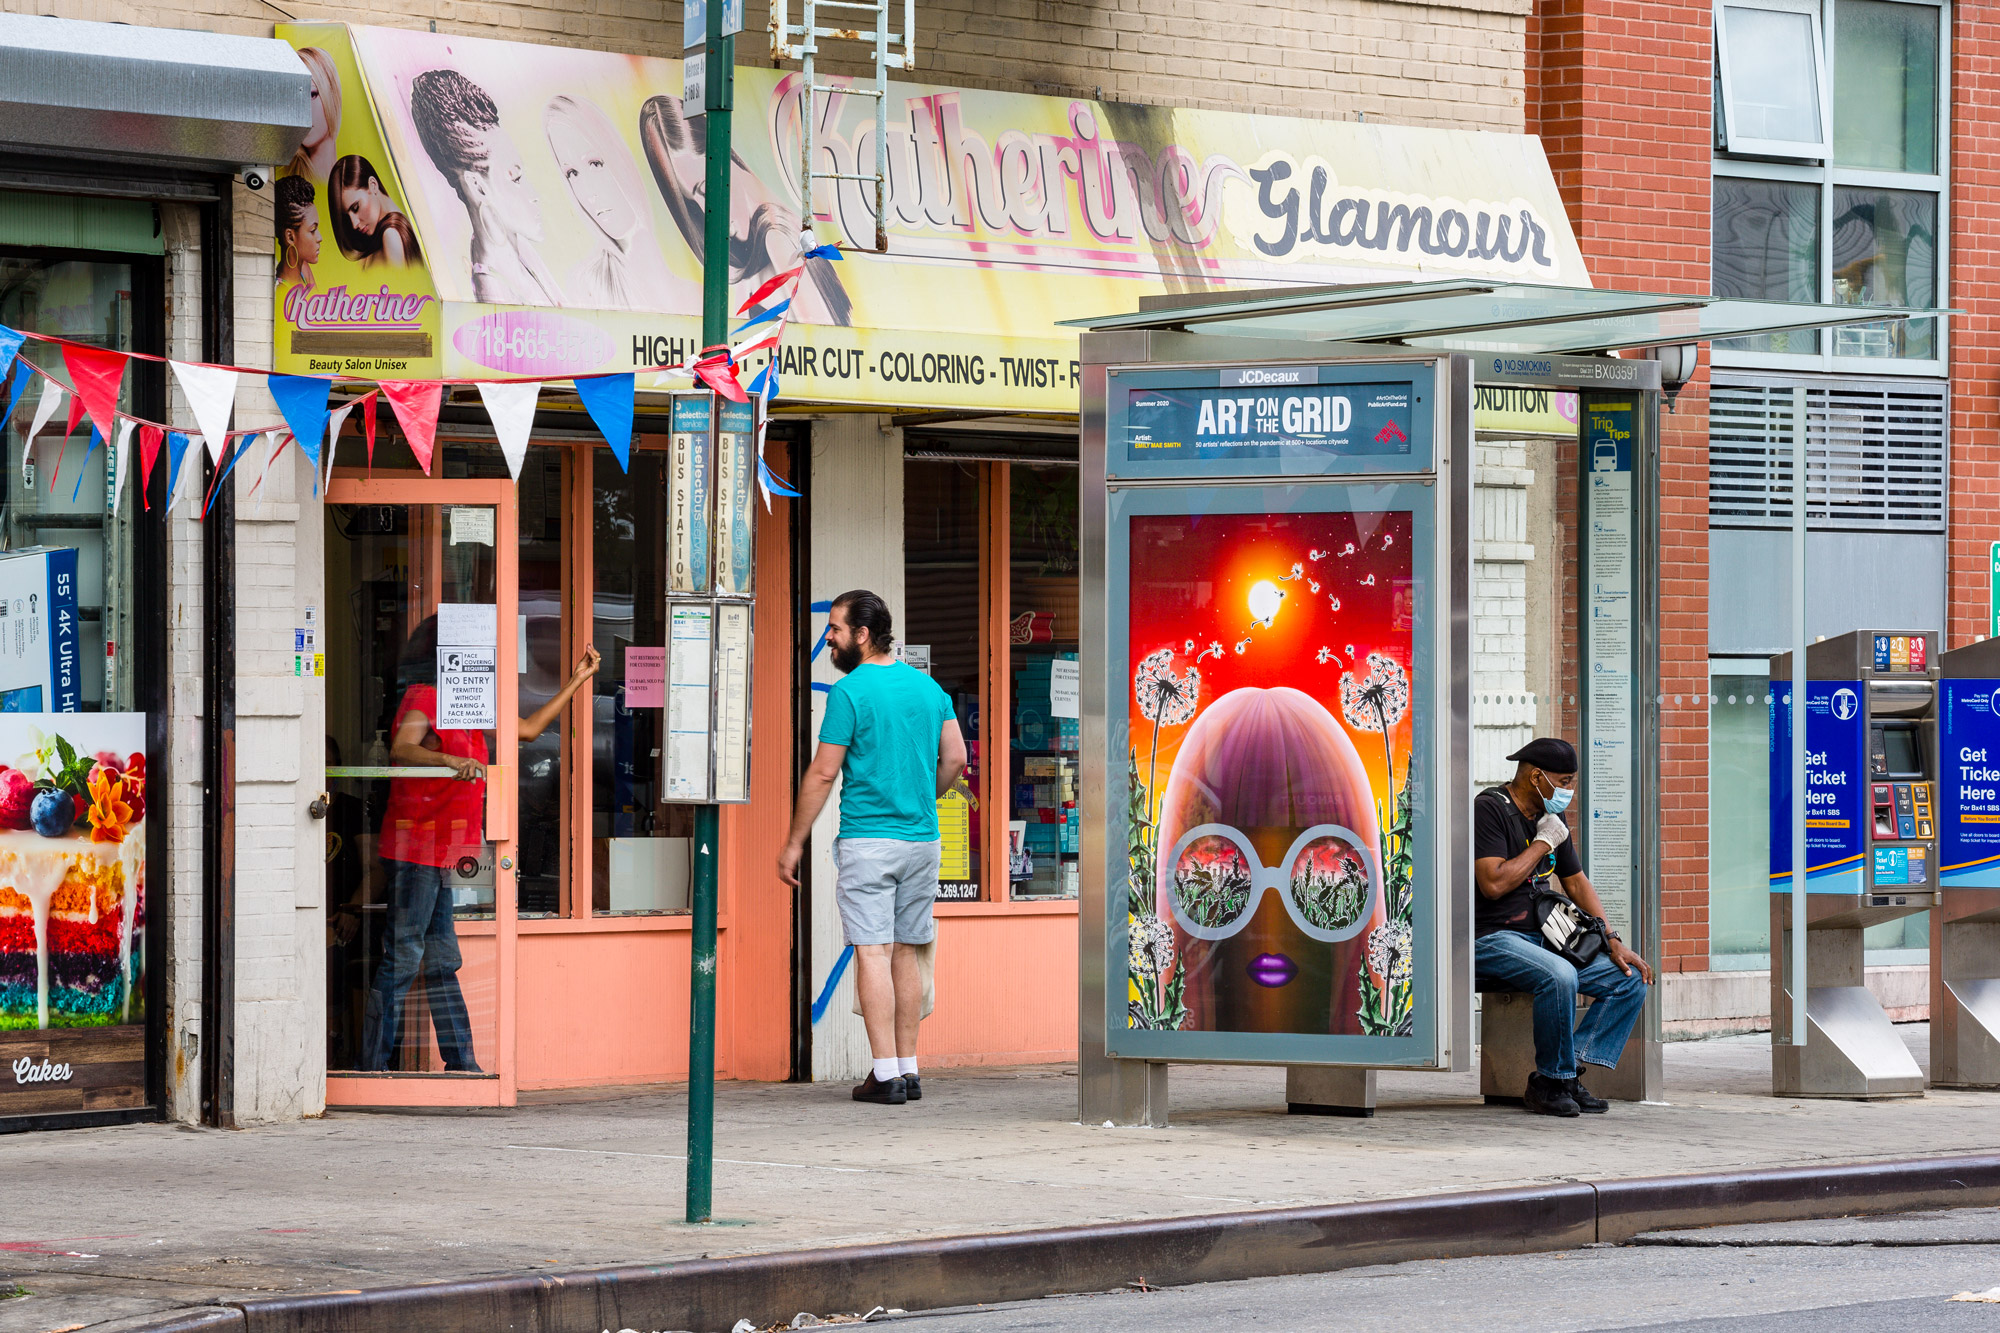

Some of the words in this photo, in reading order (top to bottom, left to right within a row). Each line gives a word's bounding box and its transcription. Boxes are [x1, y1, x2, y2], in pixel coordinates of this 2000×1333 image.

[686, 62, 700, 78] Melrose
[768, 71, 1253, 260] Katherine
[1249, 160, 1551, 267] Glamour
[284, 282, 435, 330] Katherine
[310, 359, 342, 372] Beauty
[344, 358, 372, 370] Salon
[374, 358, 407, 370] Unisex
[633, 335, 684, 367] HIGH
[769, 345, 818, 377] HAIR
[822, 347, 864, 378] CUT
[880, 352, 984, 386] COLORING
[1504, 360, 1516, 370] NO
[1516, 360, 1552, 372] SMOKING
[1238, 371, 1299, 384] JCDecaux
[1595, 364, 1638, 380] BX03591
[1256, 398, 1279, 416] ON
[1282, 396, 1352, 434] GRID
[1196, 398, 1254, 435] ART
[1592, 417, 1613, 432] Trip
[1255, 418, 1279, 433] THE
[1374, 419, 1395, 443] PUBLIC
[1608, 429, 1630, 440] Tips
[719, 489, 727, 588] STATION
[59, 610, 71, 636] 4K
[1911, 640, 1915, 649] 3
[60, 642, 72, 687] Ultra
[1806, 750, 1827, 766] Get
[1960, 747, 1987, 762] Get
[1960, 786, 1996, 800] Here
[12, 1056, 73, 1084] Cakes
